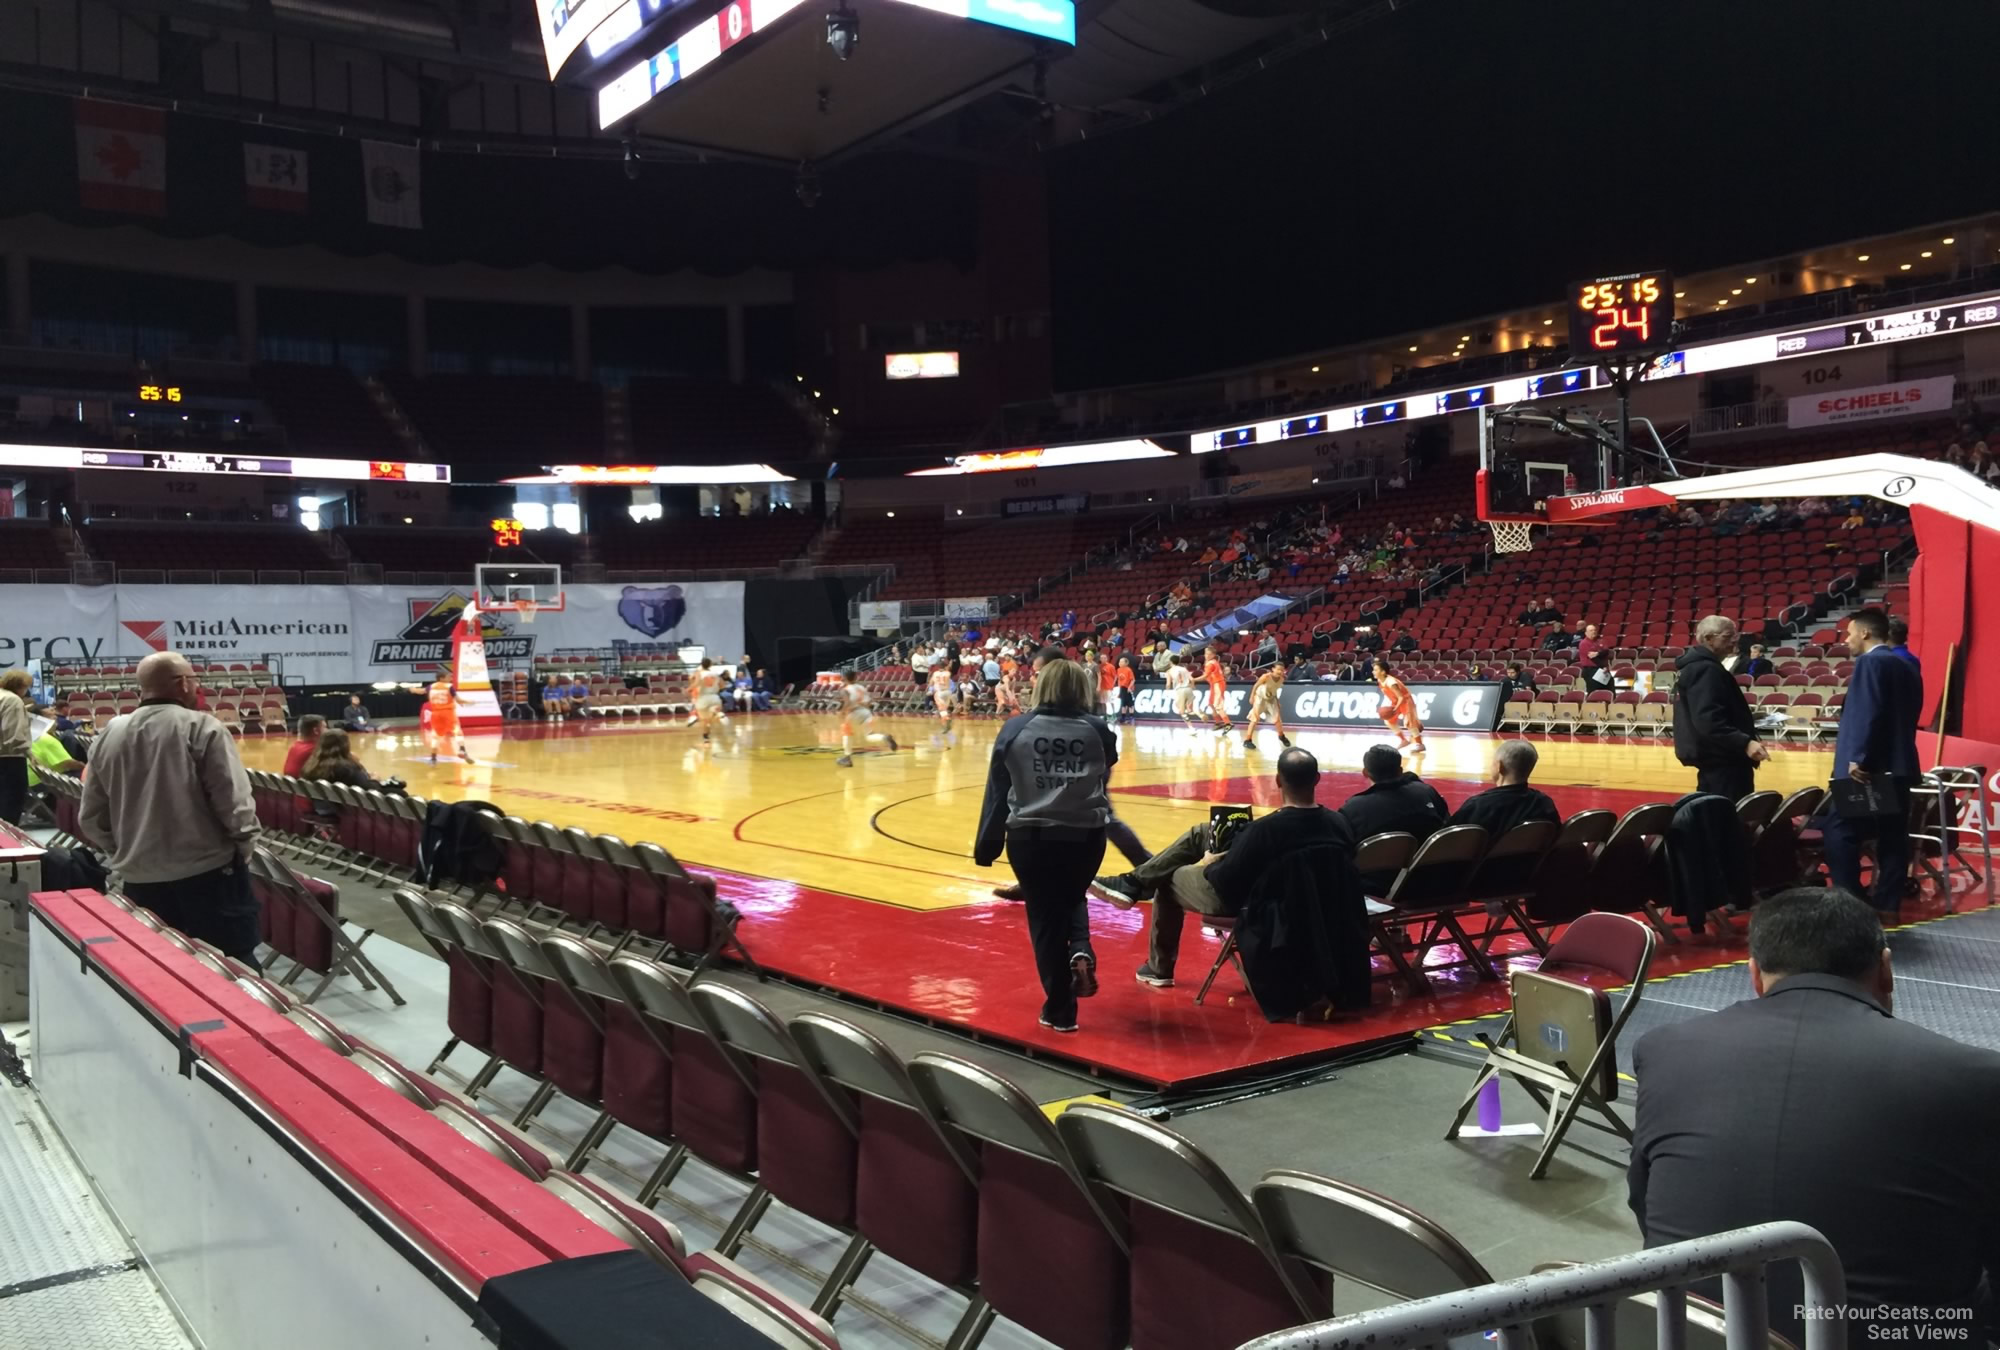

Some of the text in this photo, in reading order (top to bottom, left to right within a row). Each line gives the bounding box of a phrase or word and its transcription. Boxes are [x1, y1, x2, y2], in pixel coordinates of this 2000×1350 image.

[1595, 273, 1641, 283] DAKTRONICS
[1581, 278, 1659, 309] 25:15
[1965, 306, 1998, 324] REB
[1595, 307, 1648, 347] 24
[1852, 333, 1862, 345] 7
[1947, 317, 1957, 330] 7
[1778, 337, 1807, 352] REB
[1802, 366, 1842, 385] 104
[140, 386, 181, 402] 25:15
[1818, 388, 1922, 413] SCHEELS
[1570, 490, 1624, 511] SPALDING
[499, 531, 520, 546] 24
[173, 617, 349, 637] MidAmerican
[175, 640, 239, 649] ENERGY
[378, 644, 445, 660] PRAIRIE
[1134, 688, 1246, 716] GATAE
[1295, 690, 1436, 720] GATORE
[1452, 689, 1484, 726] G
[1033, 737, 1085, 756] CSC
[1033, 758, 1088, 773] EVENT
